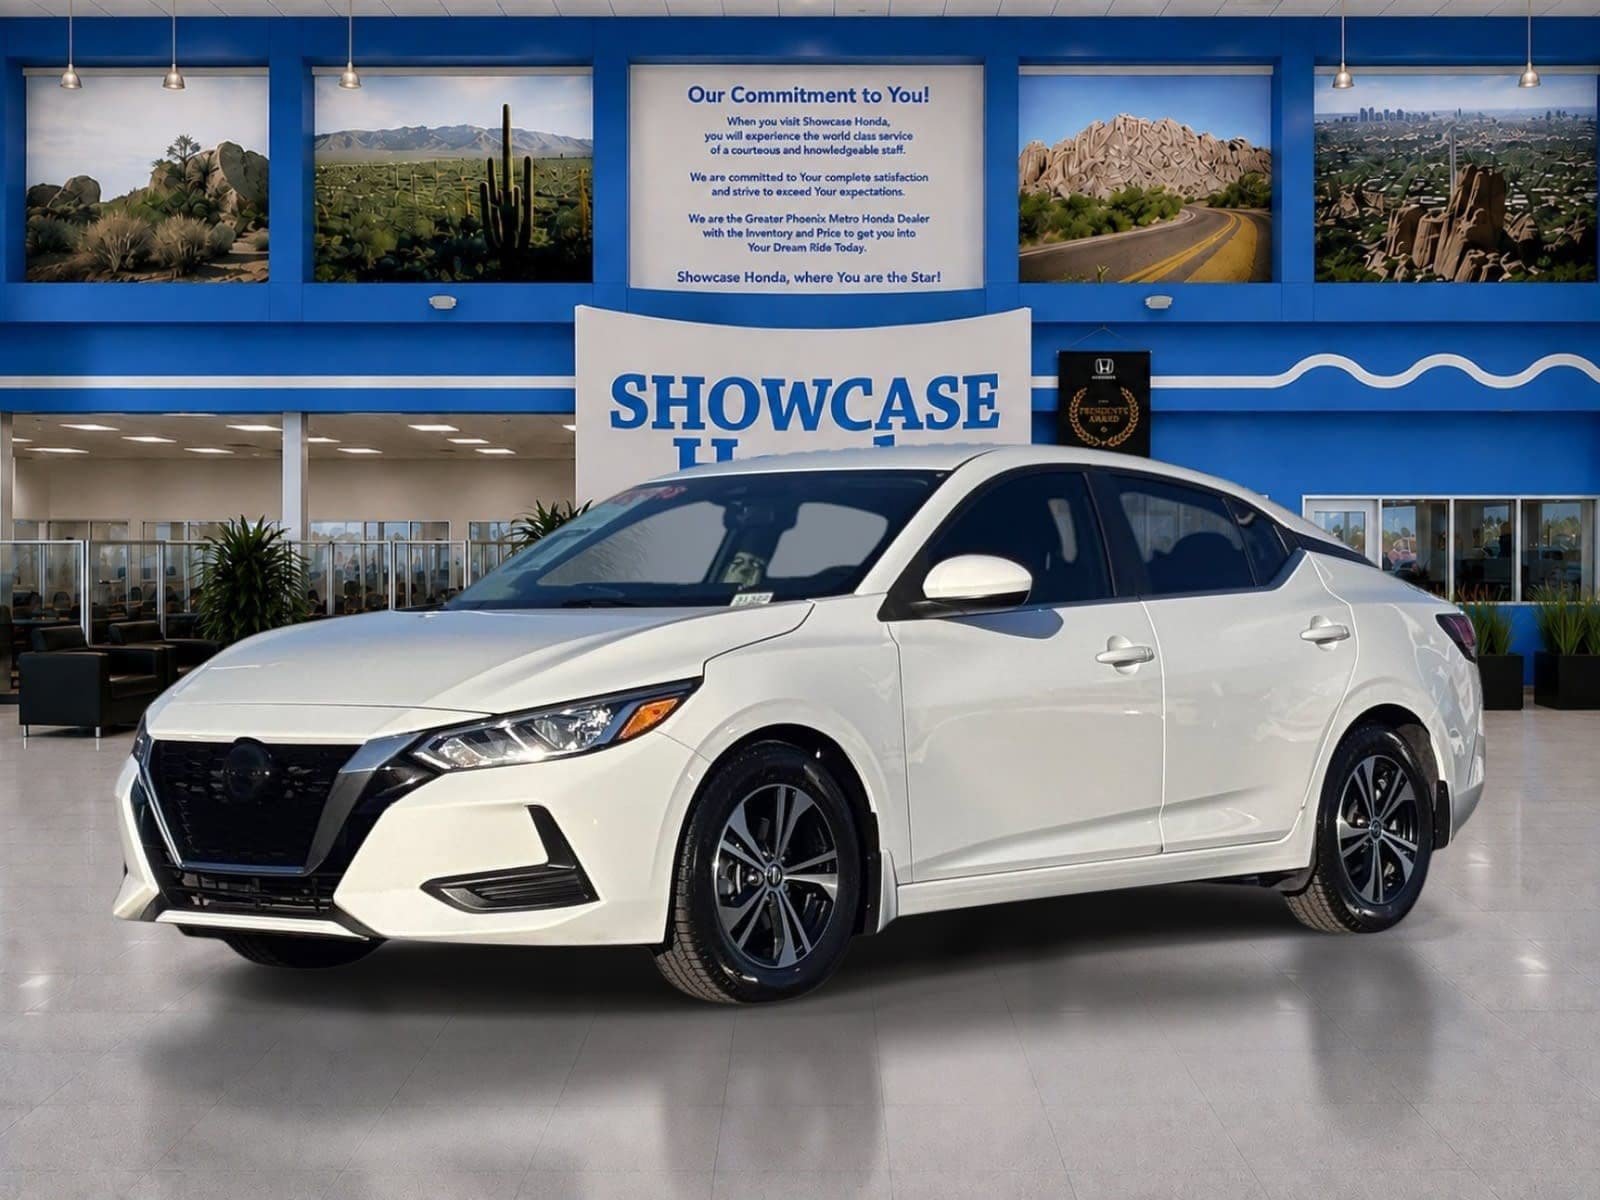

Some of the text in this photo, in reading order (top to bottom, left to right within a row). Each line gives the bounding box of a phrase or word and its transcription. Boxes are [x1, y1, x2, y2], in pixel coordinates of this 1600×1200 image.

[688, 86, 930, 103] Our Commitment to You!
[727, 116, 890, 128] When you visit Showcase Honda,
[705, 131, 913, 143] you will experience the world class service
[710, 144, 721, 154] of
[731, 146, 781, 155] courteous
[783, 145, 801, 154] and
[881, 145, 906, 154] staff.
[690, 172, 707, 182] We
[729, 172, 783, 182] committed
[800, 172, 822, 182] Your
[825, 173, 871, 184] complete
[874, 172, 928, 182] satisfaction
[712, 186, 905, 199] and strive to exceed Your expectations.
[688, 214, 706, 223] We
[726, 214, 743, 223] the
[745, 214, 784, 223] Greater
[786, 214, 826, 223] Phoenix
[829, 214, 859, 223] Metro
[862, 214, 895, 223] Honda
[897, 214, 930, 223] Dealer
[703, 228, 724, 237] with
[727, 228, 743, 238] the
[746, 228, 793, 240] Inventory
[796, 228, 814, 238] and
[817, 228, 841, 238] Price
[857, 230, 874, 240] get
[877, 231, 894, 240] you
[897, 228, 916, 237] into
[747, 243, 867, 254] Your Dream Ride Today.
[677, 271, 941, 285] Showcase Honda, where You are the Star!
[611, 373, 1000, 432] SHOWCASE
